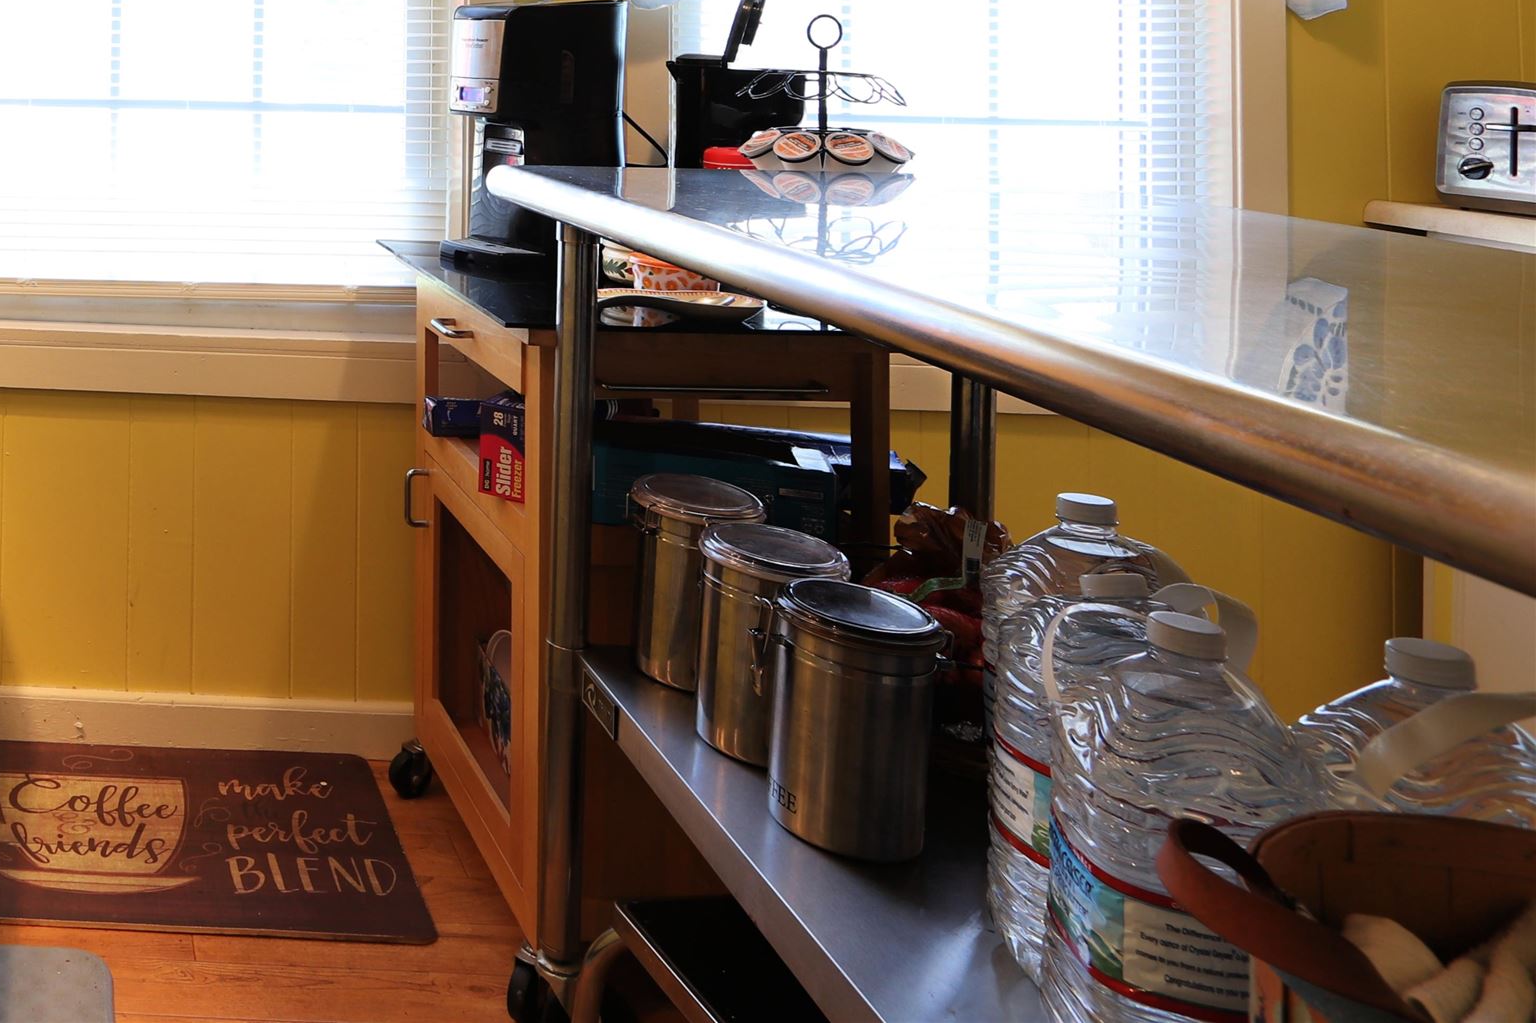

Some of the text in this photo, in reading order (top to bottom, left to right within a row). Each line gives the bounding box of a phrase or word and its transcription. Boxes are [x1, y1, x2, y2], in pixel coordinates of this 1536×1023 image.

[493, 411, 504, 426] 28
[495, 446, 512, 496] Slider
[511, 459, 523, 499] Freezer
[9, 773, 178, 827] Coffee
[218, 766, 334, 801] make
[10, 822, 171, 865] friends
[226, 810, 378, 855] perfect
[225, 852, 398, 897] BLEND
